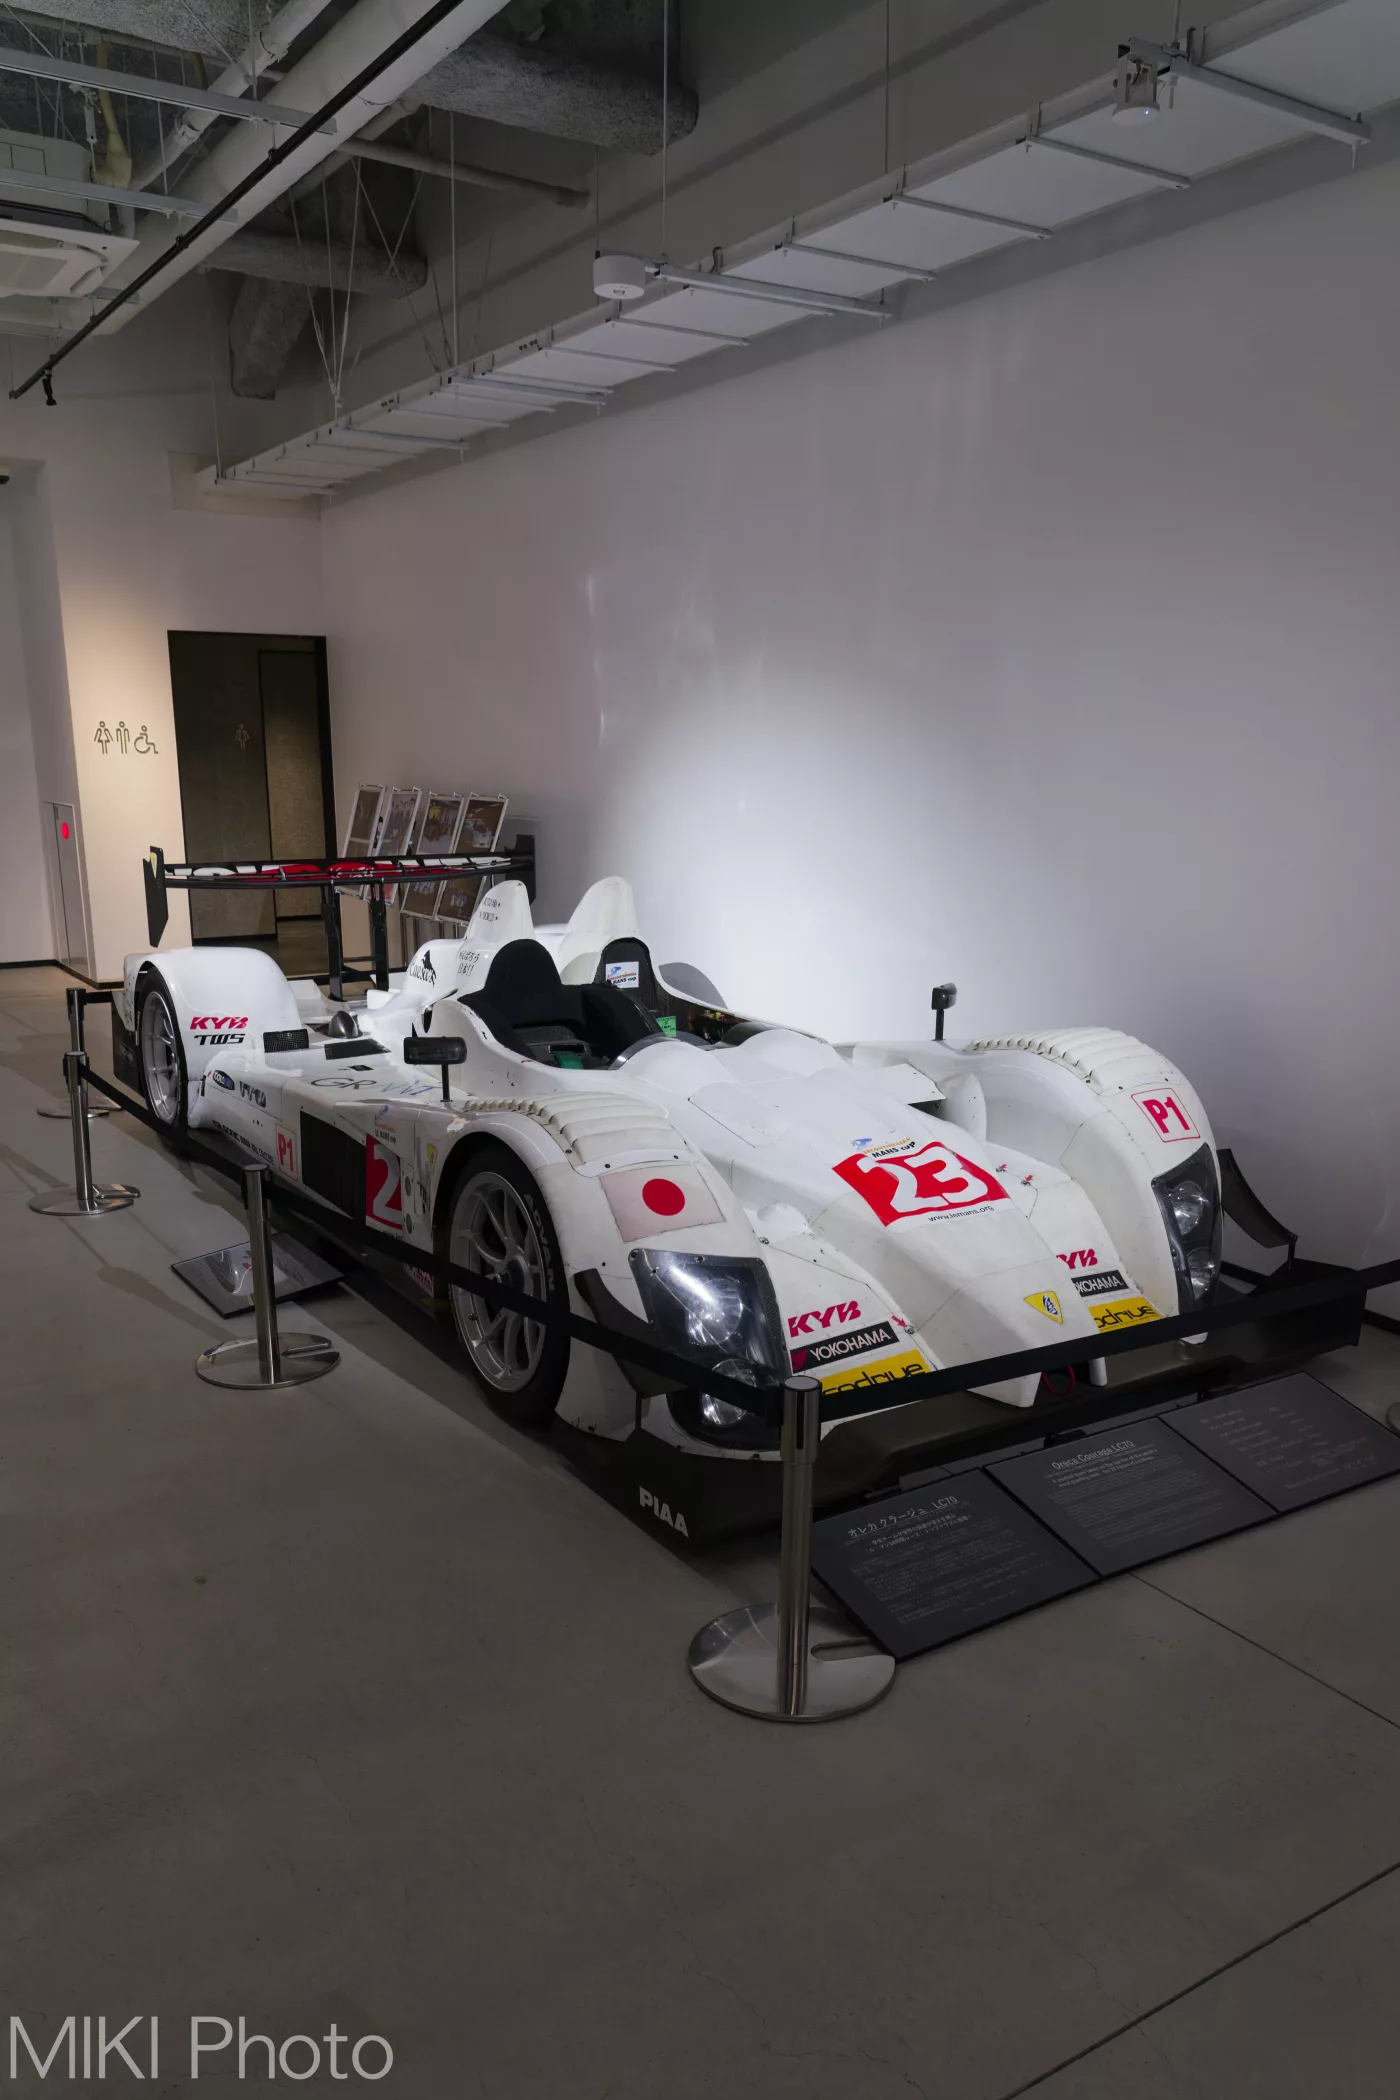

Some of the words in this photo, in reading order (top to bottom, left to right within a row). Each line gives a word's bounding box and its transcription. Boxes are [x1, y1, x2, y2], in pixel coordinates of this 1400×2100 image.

[190, 1016, 249, 1030] KYB
[193, 1033, 246, 1046] TWS
[1142, 1096, 1190, 1134] P1
[278, 1132, 294, 1172] P1
[872, 1147, 900, 1159] MANS
[856, 1147, 989, 1213] 23
[928, 1204, 995, 1222] www.lemans.org
[1056, 1248, 1098, 1270] YB
[788, 1300, 862, 1338] KYB
[810, 1328, 891, 1361] YOKOHAMA
[1052, 1457, 1078, 1469] Oreca
[1077, 1446, 1113, 1463] Courage
[1111, 1440, 1135, 1452] LC70
[639, 1485, 689, 1538] PIAA
[931, 1495, 959, 1509] LC70
